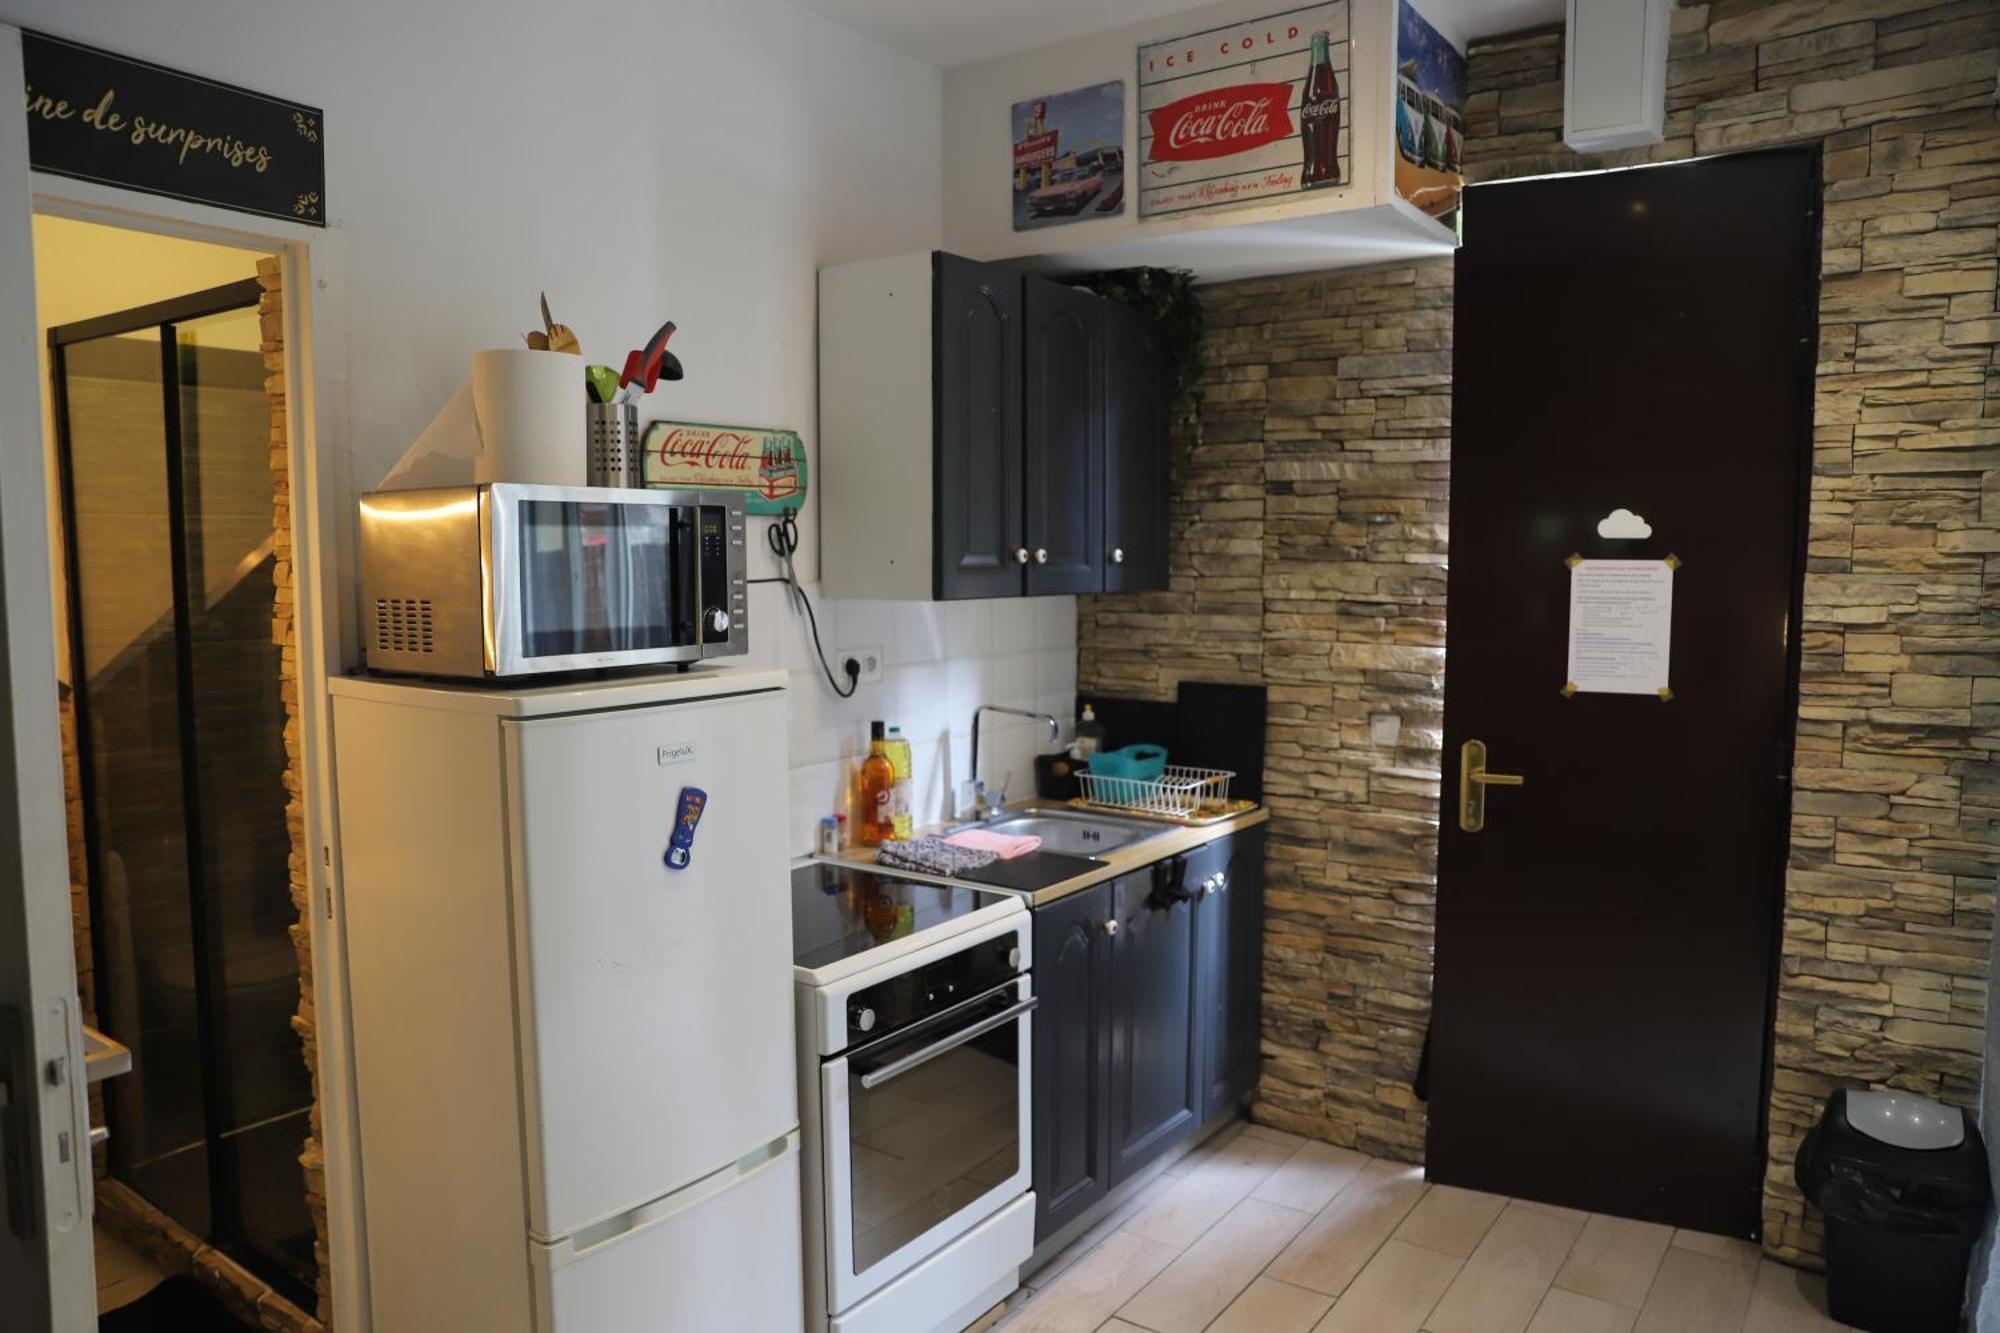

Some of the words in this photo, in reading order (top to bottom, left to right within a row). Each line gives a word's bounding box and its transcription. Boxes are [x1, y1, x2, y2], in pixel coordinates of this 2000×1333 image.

[1149, 51, 1194, 73] ICE
[1220, 26, 1299, 55] COLD
[1169, 97, 1272, 149] Coca-Cola
[1194, 101, 1227, 113] DRINK
[1302, 100, 1338, 118] Coca-Cola
[82, 89, 127, 131] de
[131, 116, 272, 172] surprises
[660, 428, 752, 470] Coca-Cola
